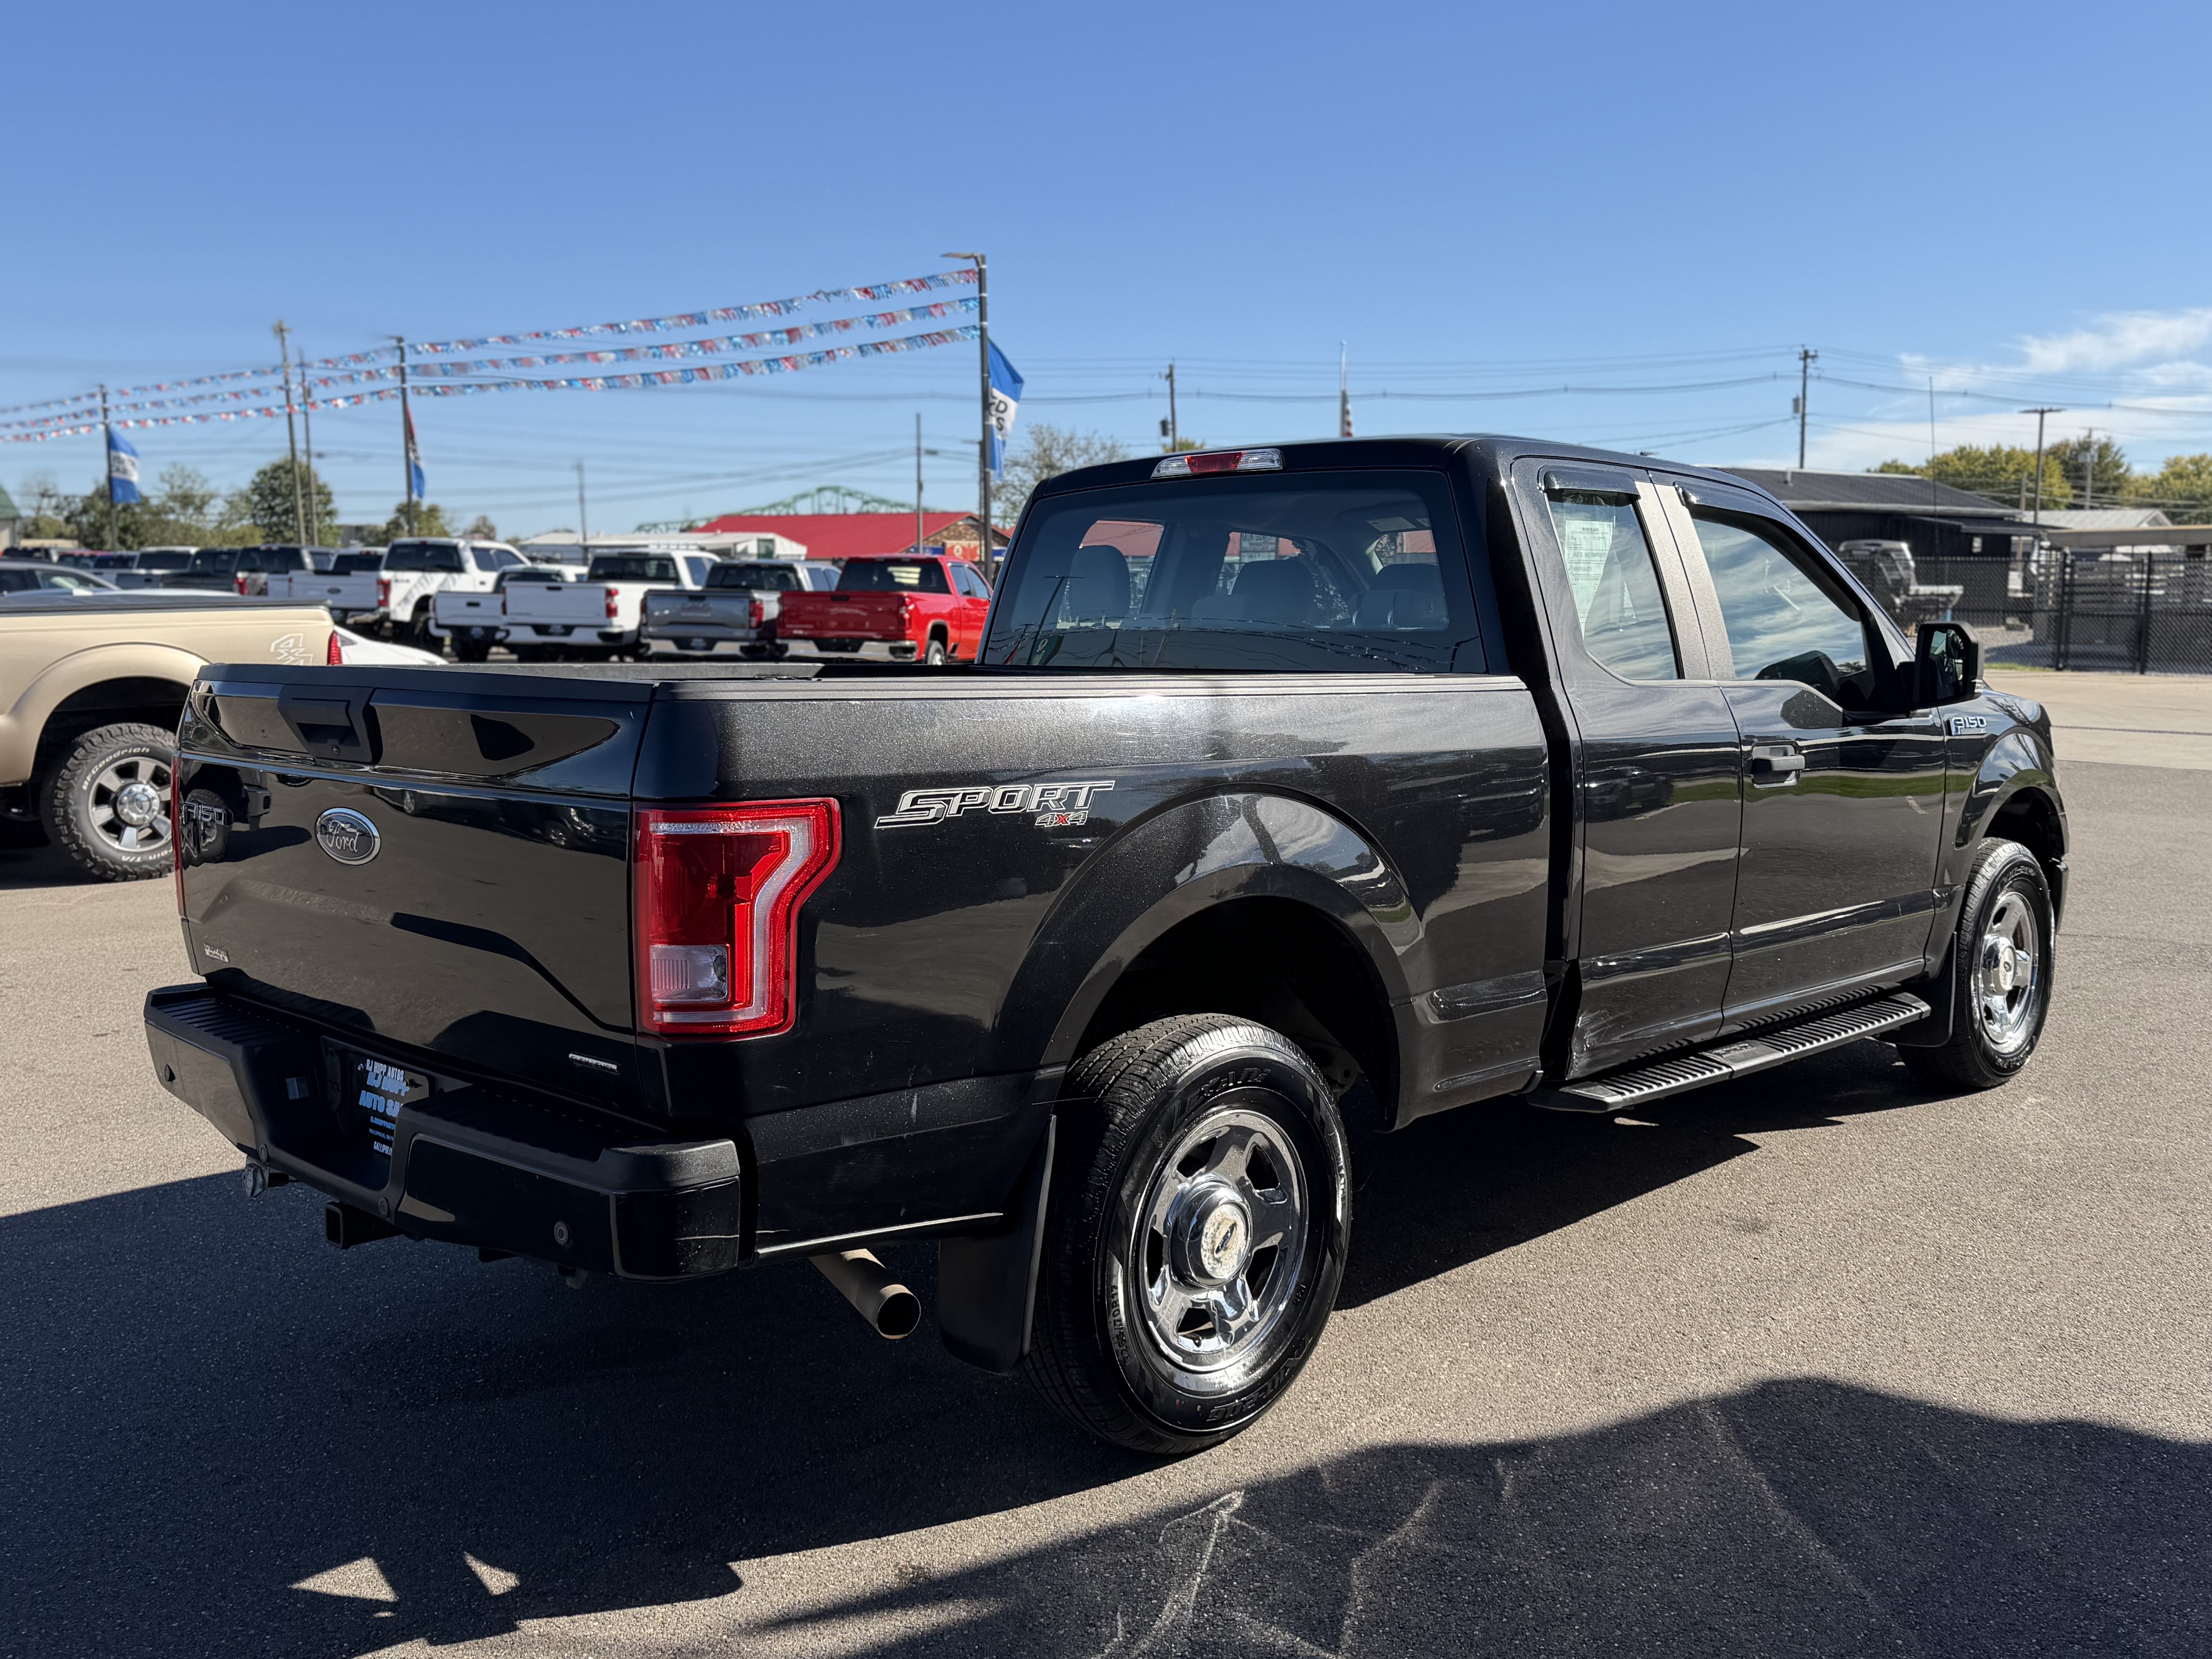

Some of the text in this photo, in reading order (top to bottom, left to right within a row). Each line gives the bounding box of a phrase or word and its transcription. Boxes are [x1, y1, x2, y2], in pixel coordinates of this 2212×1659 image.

[874, 780, 1116, 829] SPORT
[327, 819, 361, 853] Ford
[387, 1066, 404, 1082] AUTOS
[359, 1090, 385, 1113] AUTO
